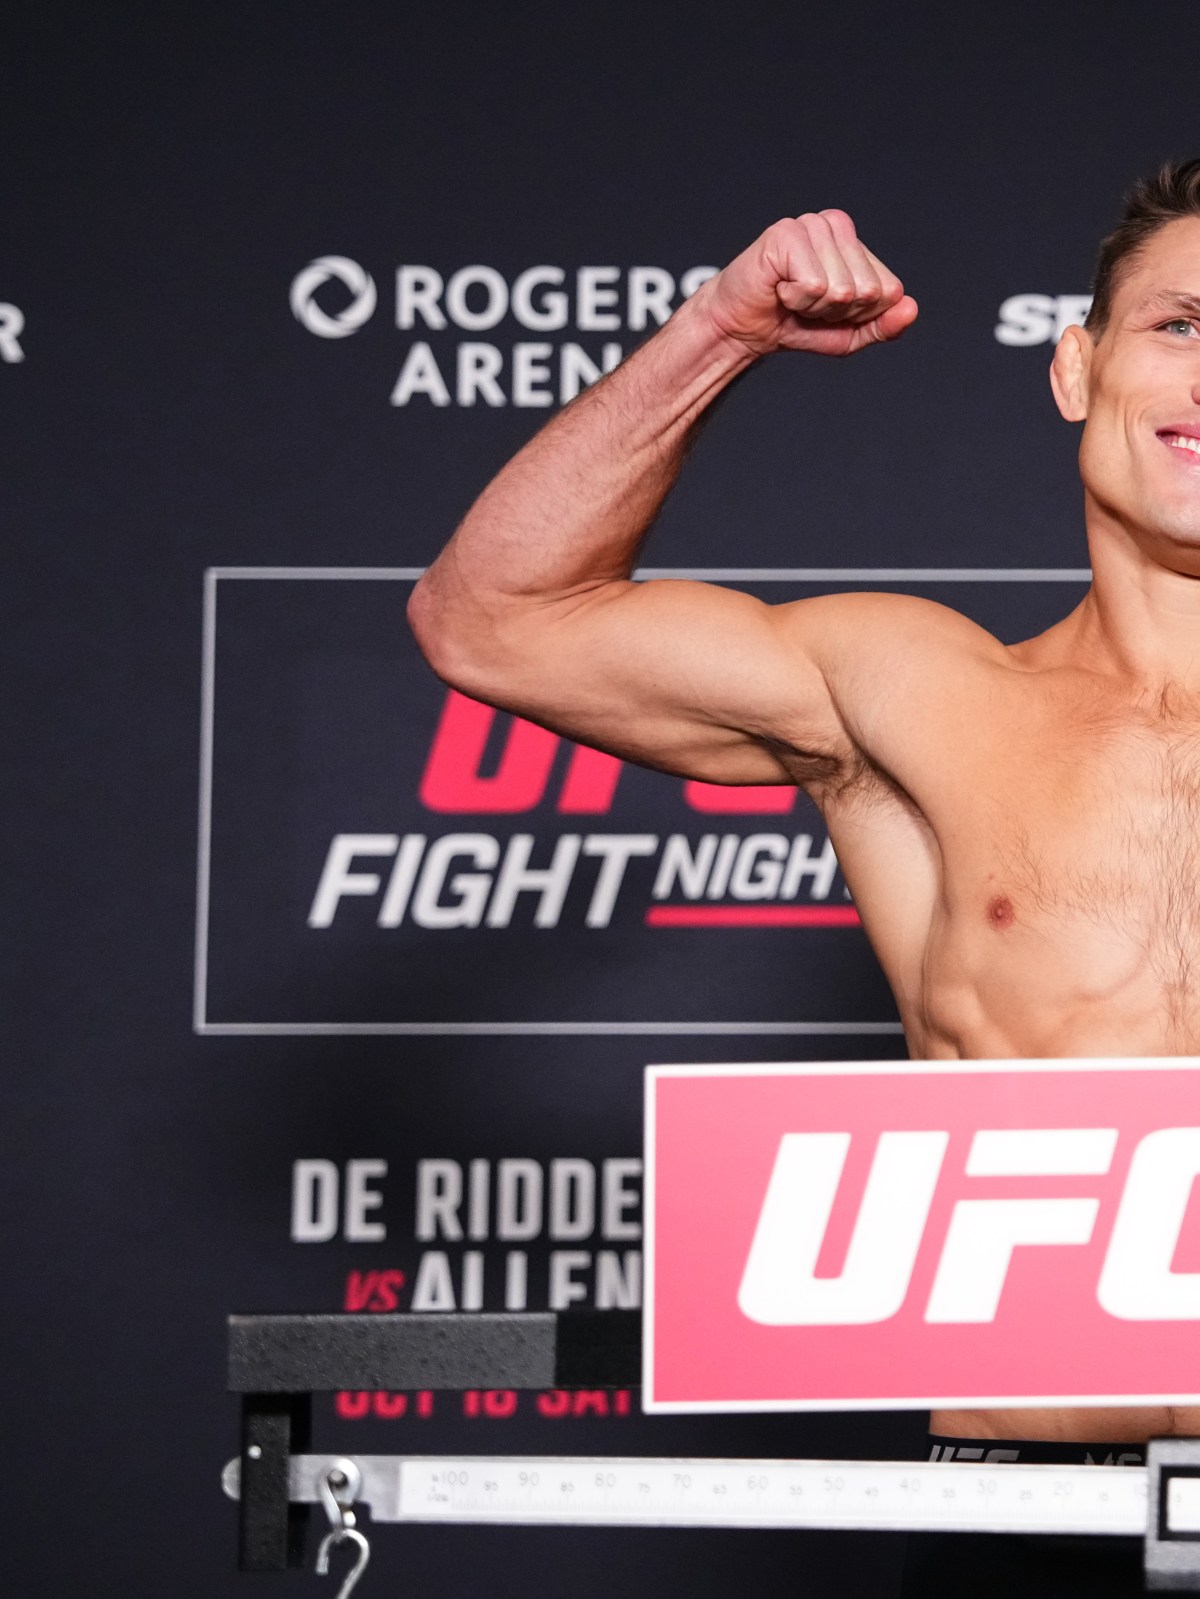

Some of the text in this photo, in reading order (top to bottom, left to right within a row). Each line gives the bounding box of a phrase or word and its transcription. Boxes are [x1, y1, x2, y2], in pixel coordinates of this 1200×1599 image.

[308, 833, 852, 929] FIGHT NIGH
[290, 1158, 388, 1243] DE
[344, 1269, 405, 1312] VS
